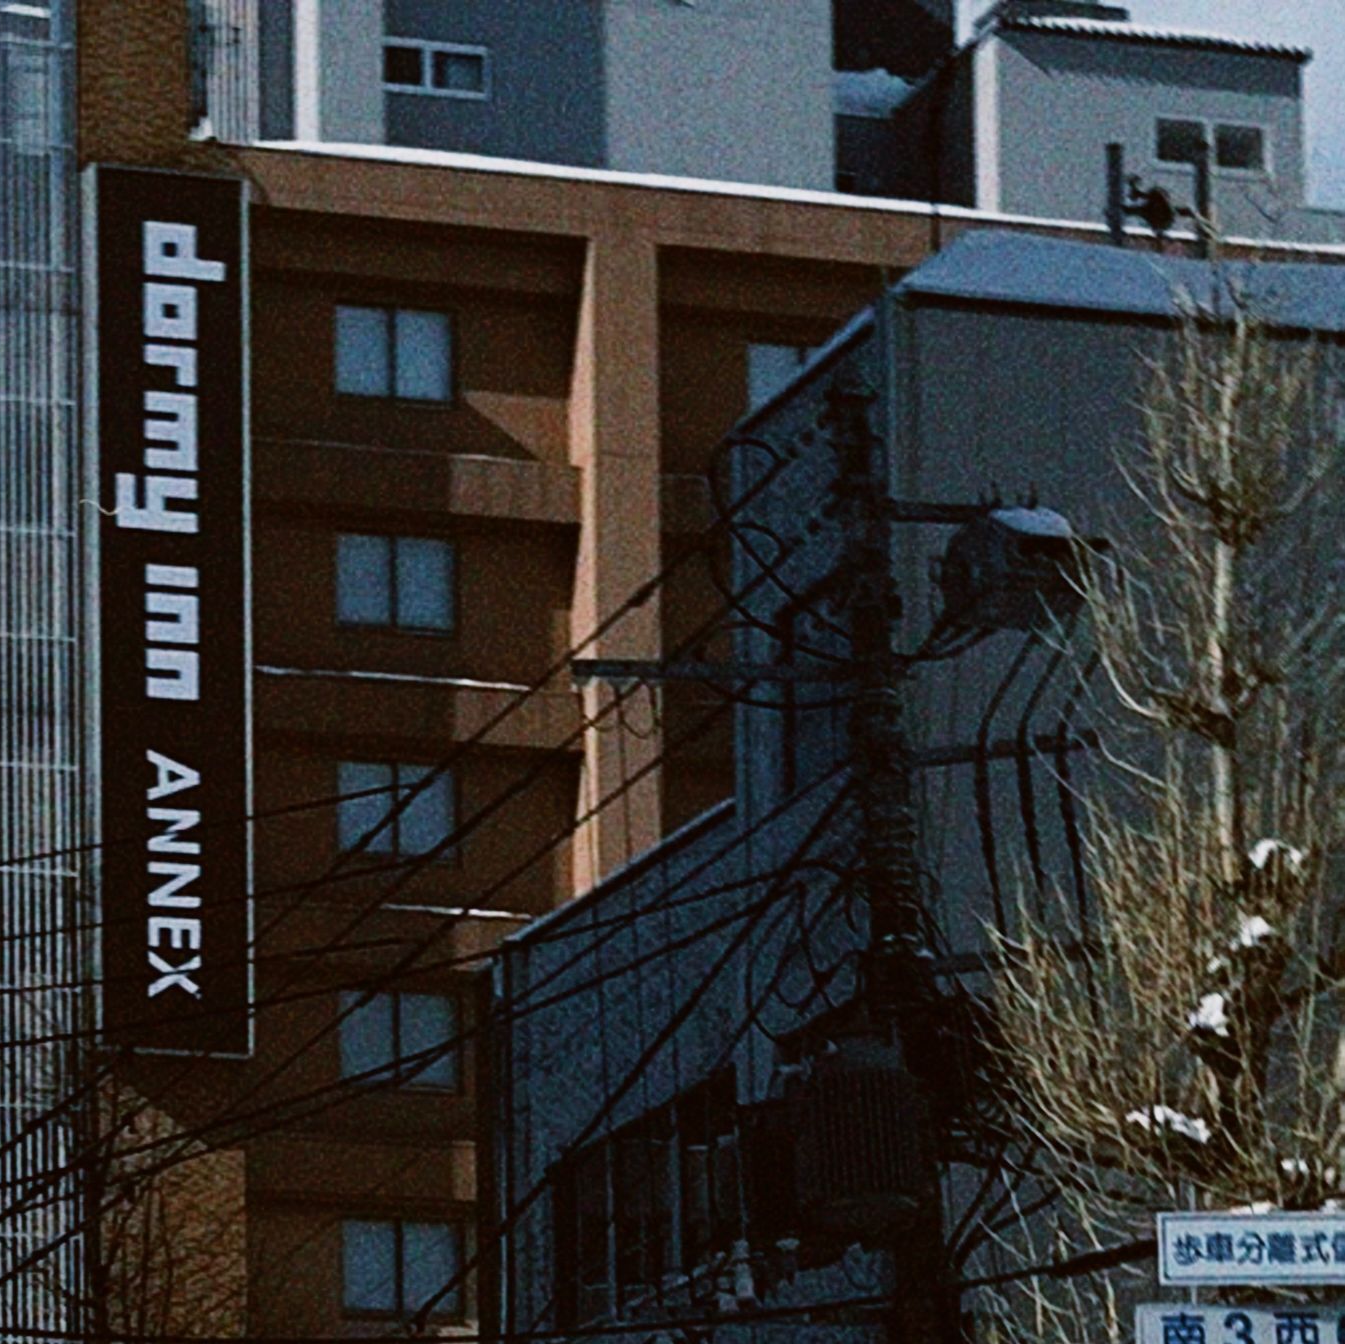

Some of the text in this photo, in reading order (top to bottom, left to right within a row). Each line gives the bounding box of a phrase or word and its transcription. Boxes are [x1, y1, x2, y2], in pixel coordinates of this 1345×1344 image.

[115, 220, 227, 998] dormy inn ANNEX
